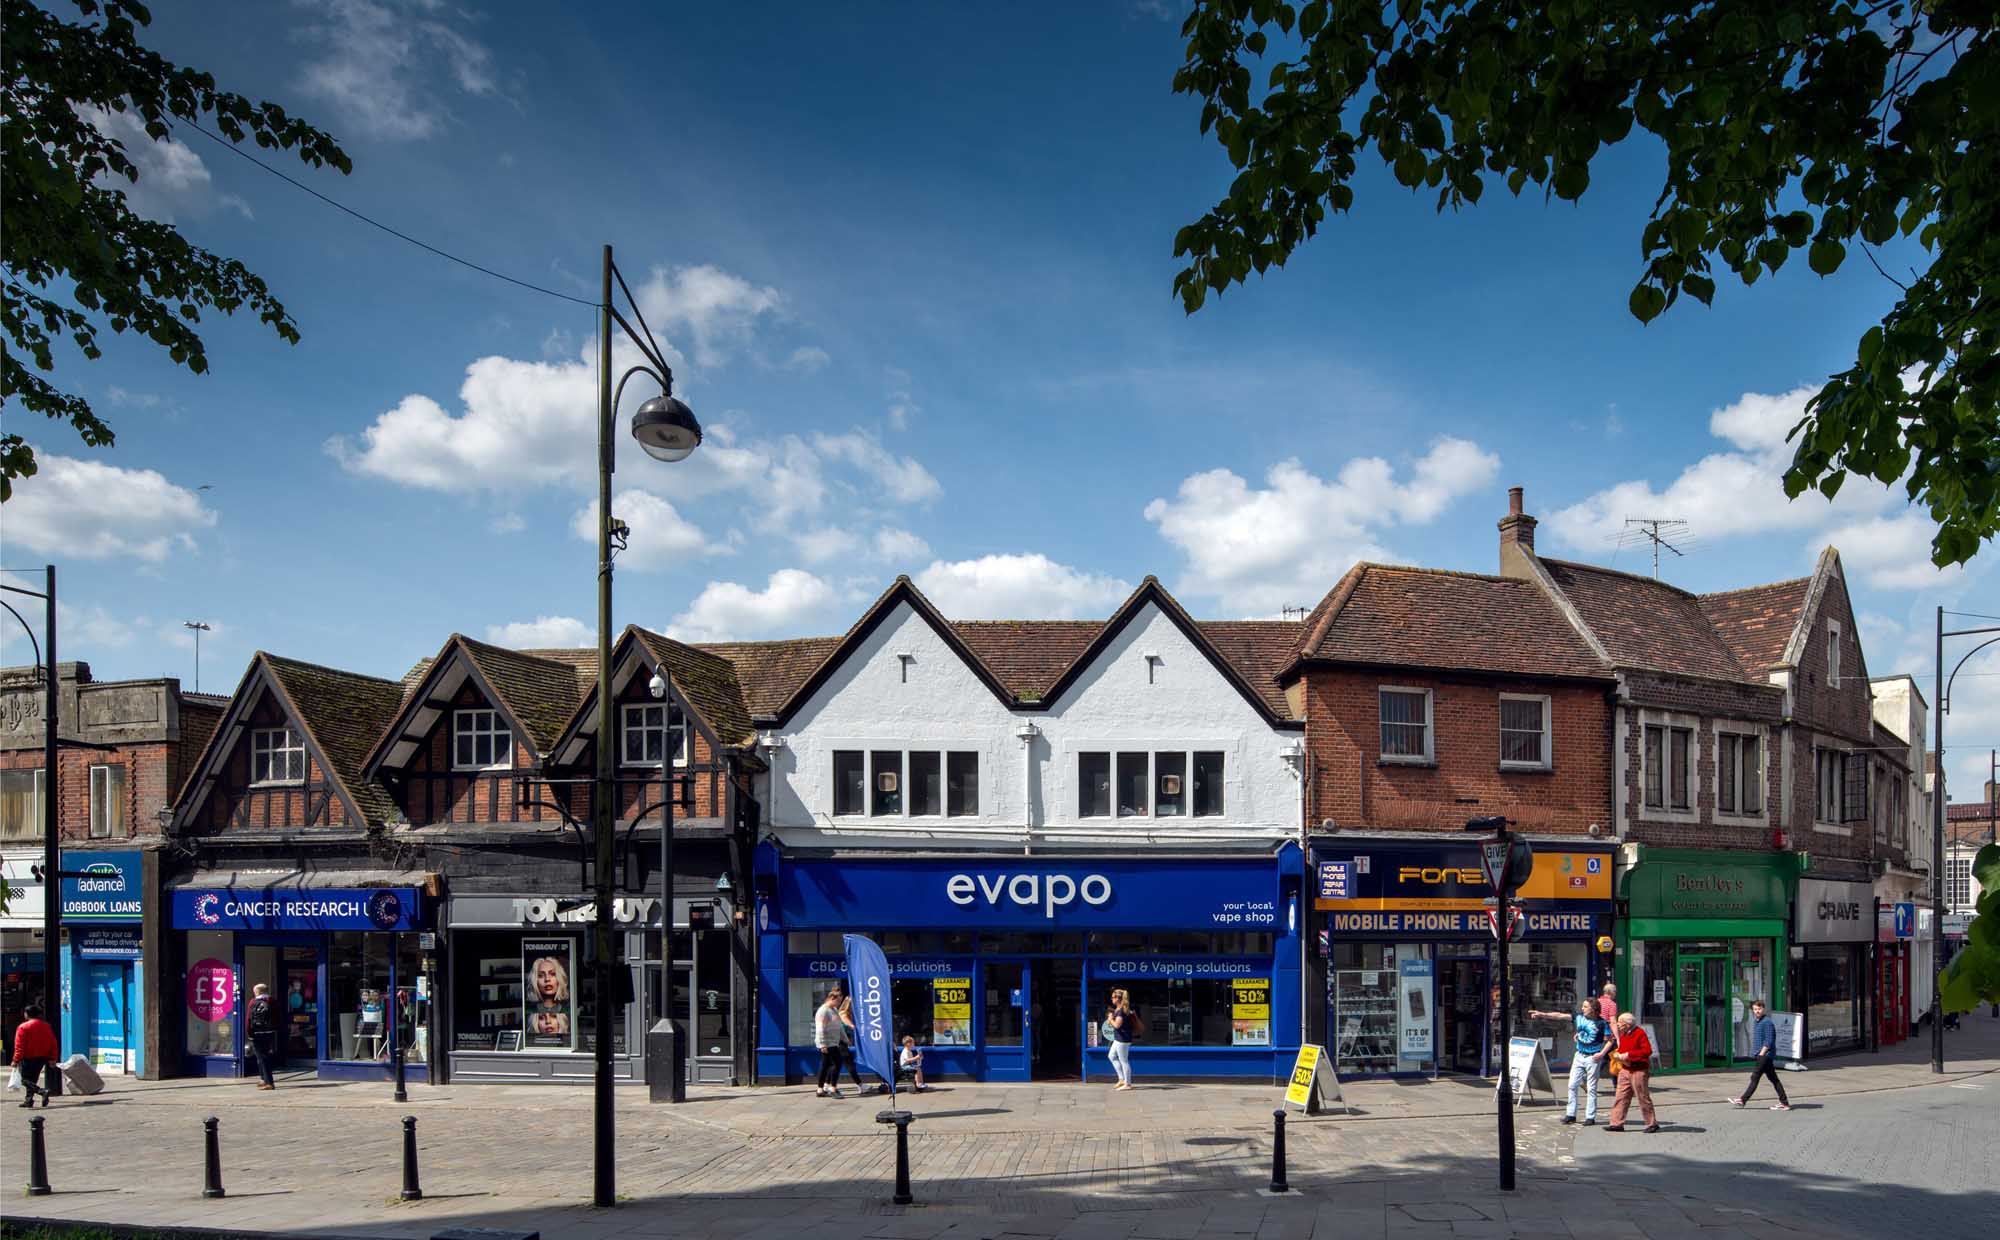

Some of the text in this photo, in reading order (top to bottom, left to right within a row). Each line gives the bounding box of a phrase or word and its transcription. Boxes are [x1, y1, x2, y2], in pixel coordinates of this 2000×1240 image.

[1487, 847, 1506, 858] GIVE
[80, 877, 122, 892] advance
[946, 874, 1112, 918] evapo
[64, 901, 141, 912] LOGBOOK LOANS
[225, 902, 281, 916] CANCER
[286, 902, 359, 916] RESEARCH
[1223, 902, 1274, 911] your local
[1817, 902, 1860, 920] CRAVE
[1212, 912, 1274, 924] vape shop
[1335, 914, 1399, 930] MOBILE
[1403, 914, 1460, 930] PHONE
[1528, 914, 1591, 930] CENTRE
[810, 961, 837, 972] CBD
[897, 961, 952, 972] solutions
[1109, 961, 1251, 974] CBD & Vaping solutions
[195, 976, 227, 1005] £3
[940, 989, 966, 1003] 50%
[1239, 990, 1265, 1003] 50%
[863, 975, 882, 1041] evapo
[1808, 1029, 1833, 1040] CRAVE
